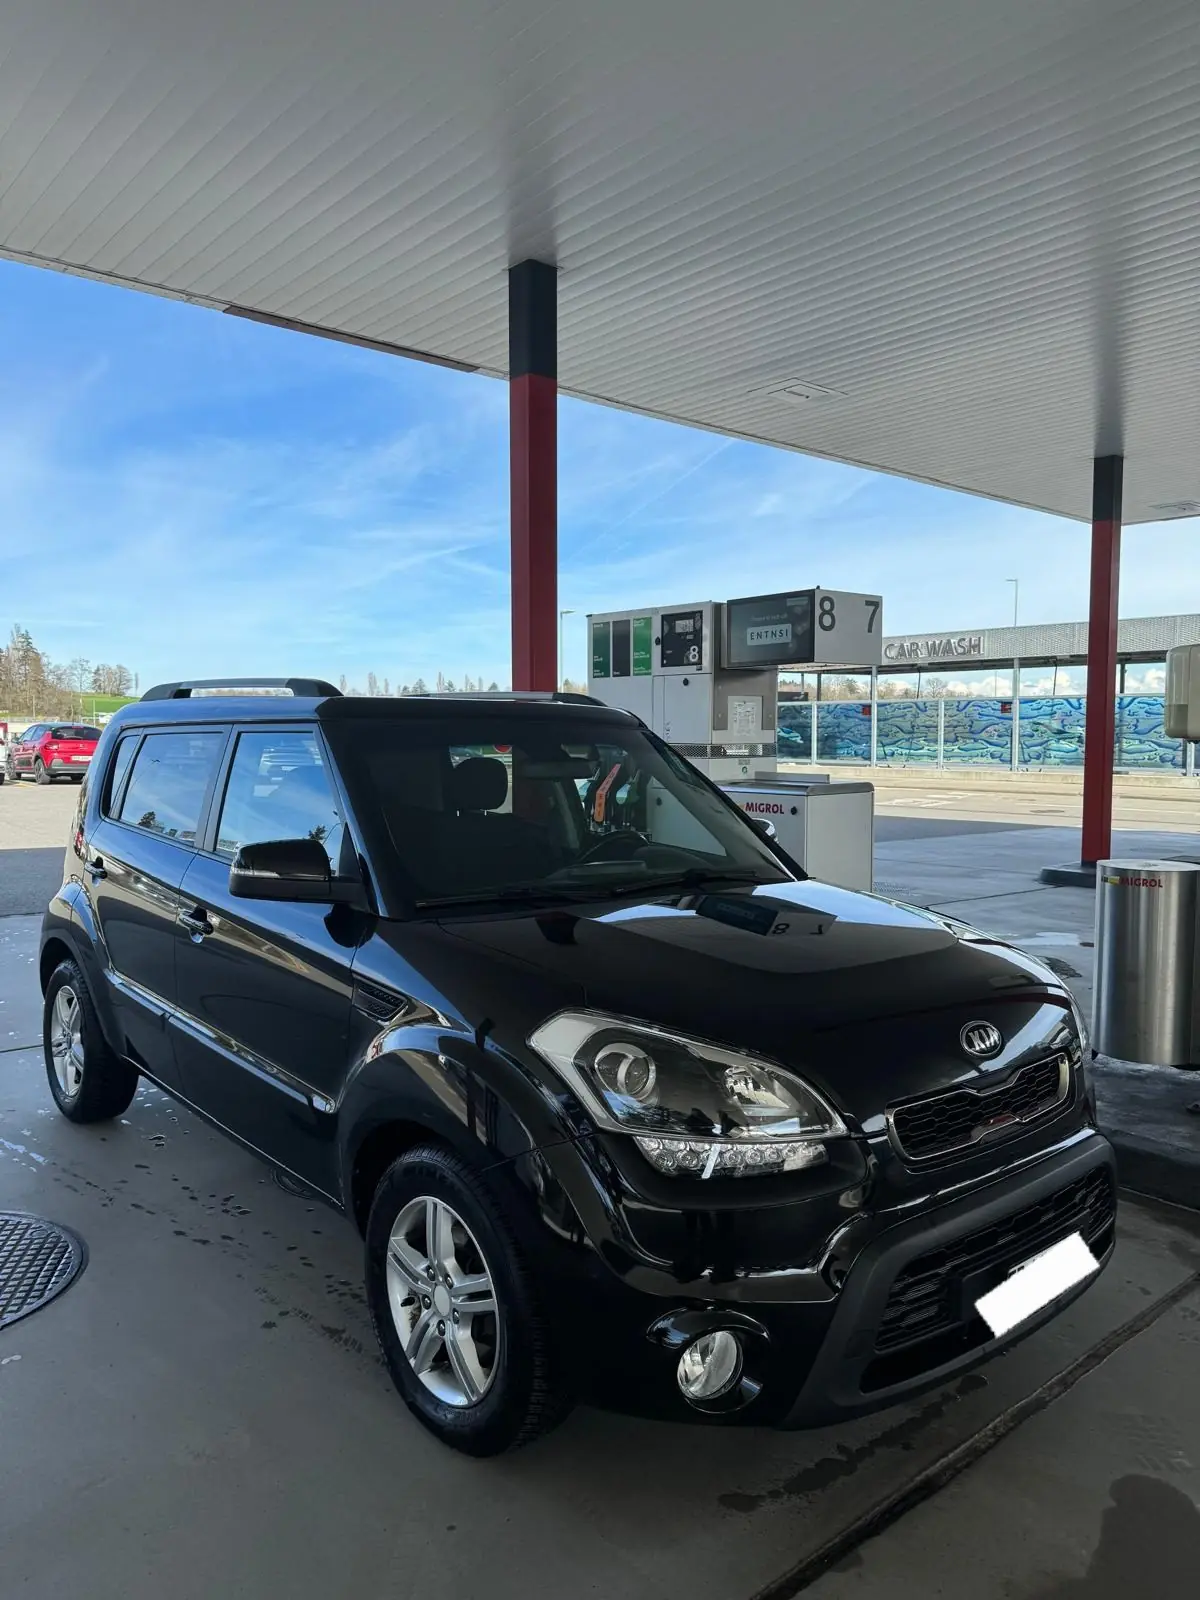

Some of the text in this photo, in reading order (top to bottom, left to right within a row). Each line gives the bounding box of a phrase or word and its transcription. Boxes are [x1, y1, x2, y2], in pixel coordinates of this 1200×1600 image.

[819, 596, 880, 633] 8 7
[750, 628, 788, 641] ENTNSI
[690, 645, 699, 662] 8
[884, 637, 984, 660] CAR WASH
[745, 802, 785, 814] MIGROL
[1119, 876, 1163, 888] MIGROL
[967, 1027, 1000, 1051] KIA
